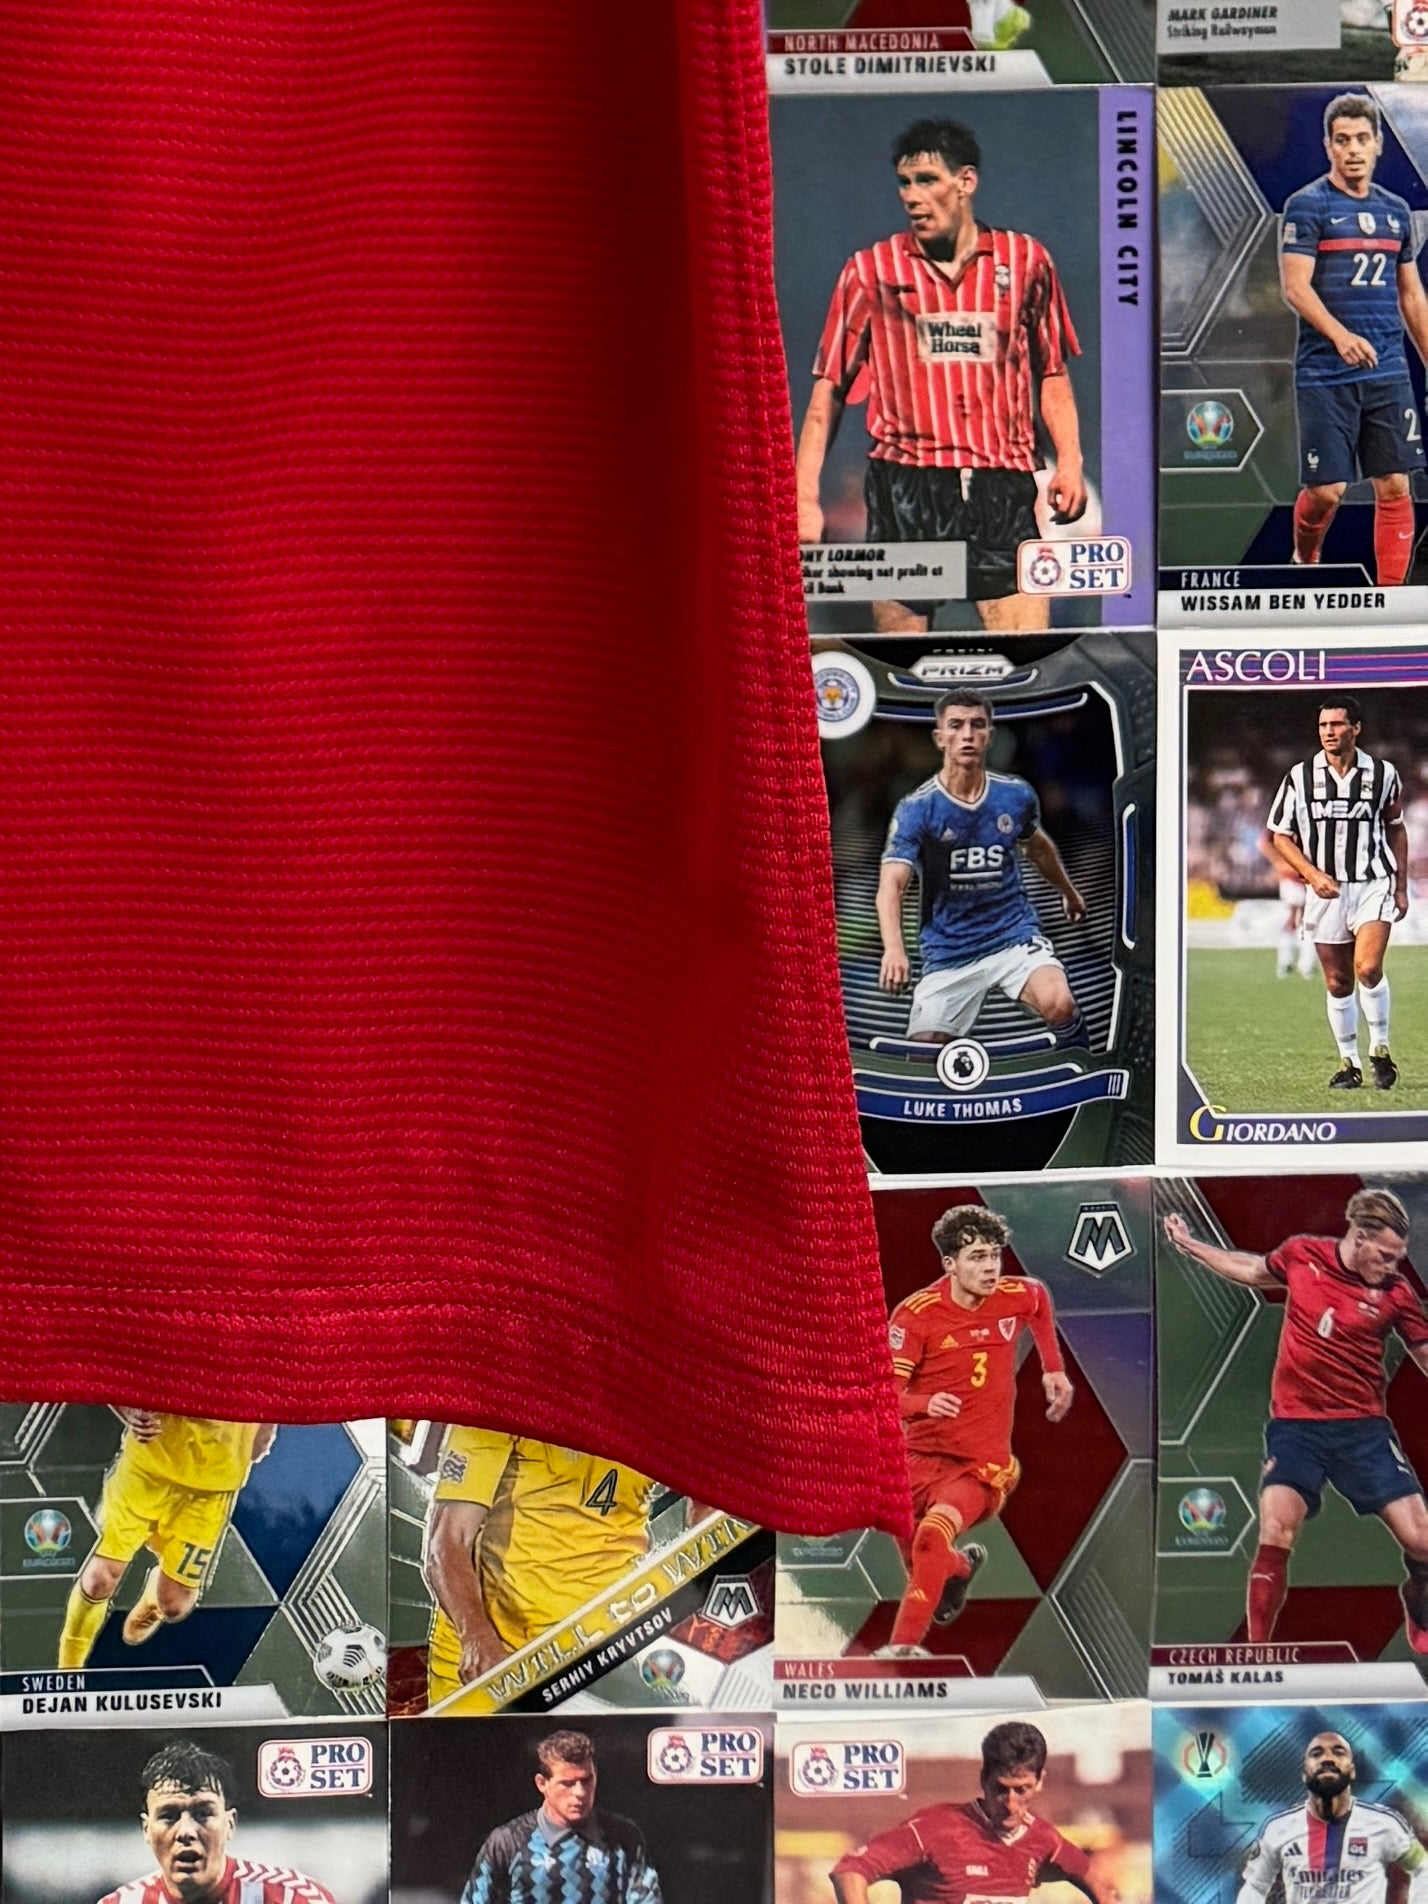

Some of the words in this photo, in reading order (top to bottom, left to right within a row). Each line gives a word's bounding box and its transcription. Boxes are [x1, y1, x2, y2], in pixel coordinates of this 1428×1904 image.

[1168, 8, 1206, 21] MARK
[1211, 6, 1278, 20] GARDINER
[784, 34, 839, 52] NORTH
[844, 33, 939, 50] MACEDONIA
[784, 56, 847, 75] STOLE
[854, 54, 995, 74] DIMITRIEVSKI
[1116, 111, 1138, 230] LINCOLN
[1120, 247, 1139, 306] CITY
[1351, 253, 1387, 288] 22
[927, 322, 981, 340] Wheel
[1070, 543, 1124, 563] PRO
[1070, 568, 1124, 588] SET
[1181, 571, 1241, 588] FRANCE
[1181, 593, 1261, 611] WISSAM
[1269, 593, 1309, 610] BEN
[1314, 591, 1386, 609] YEDDER
[1187, 651, 1327, 681] ASCOLI
[949, 846, 1004, 871] FBS
[904, 1098, 945, 1115] LUKE
[952, 1096, 1023, 1115] THOMAS
[1188, 1105, 1337, 1143] GIORDANO
[971, 1353, 990, 1388] 3
[541, 1666, 596, 1703] SERHIY
[595, 1607, 675, 1670] KRYVTSOV
[1168, 1647, 1211, 1663] CZECH
[1215, 1647, 1300, 1663] REPUBLIC
[784, 1663, 835, 1678] WALES
[1168, 1669, 1224, 1686] TOMÁŠ
[1228, 1668, 1284, 1685] KALAS
[21, 1673, 86, 1691] SWEDEN
[782, 1682, 839, 1700] NECO
[843, 1680, 949, 1700] WILLIAMS
[22, 1695, 89, 1715] DEJAN
[95, 1690, 223, 1711] KULUSEVSKI
[701, 1732, 756, 1753] PRO
[701, 1756, 757, 1777] SET
